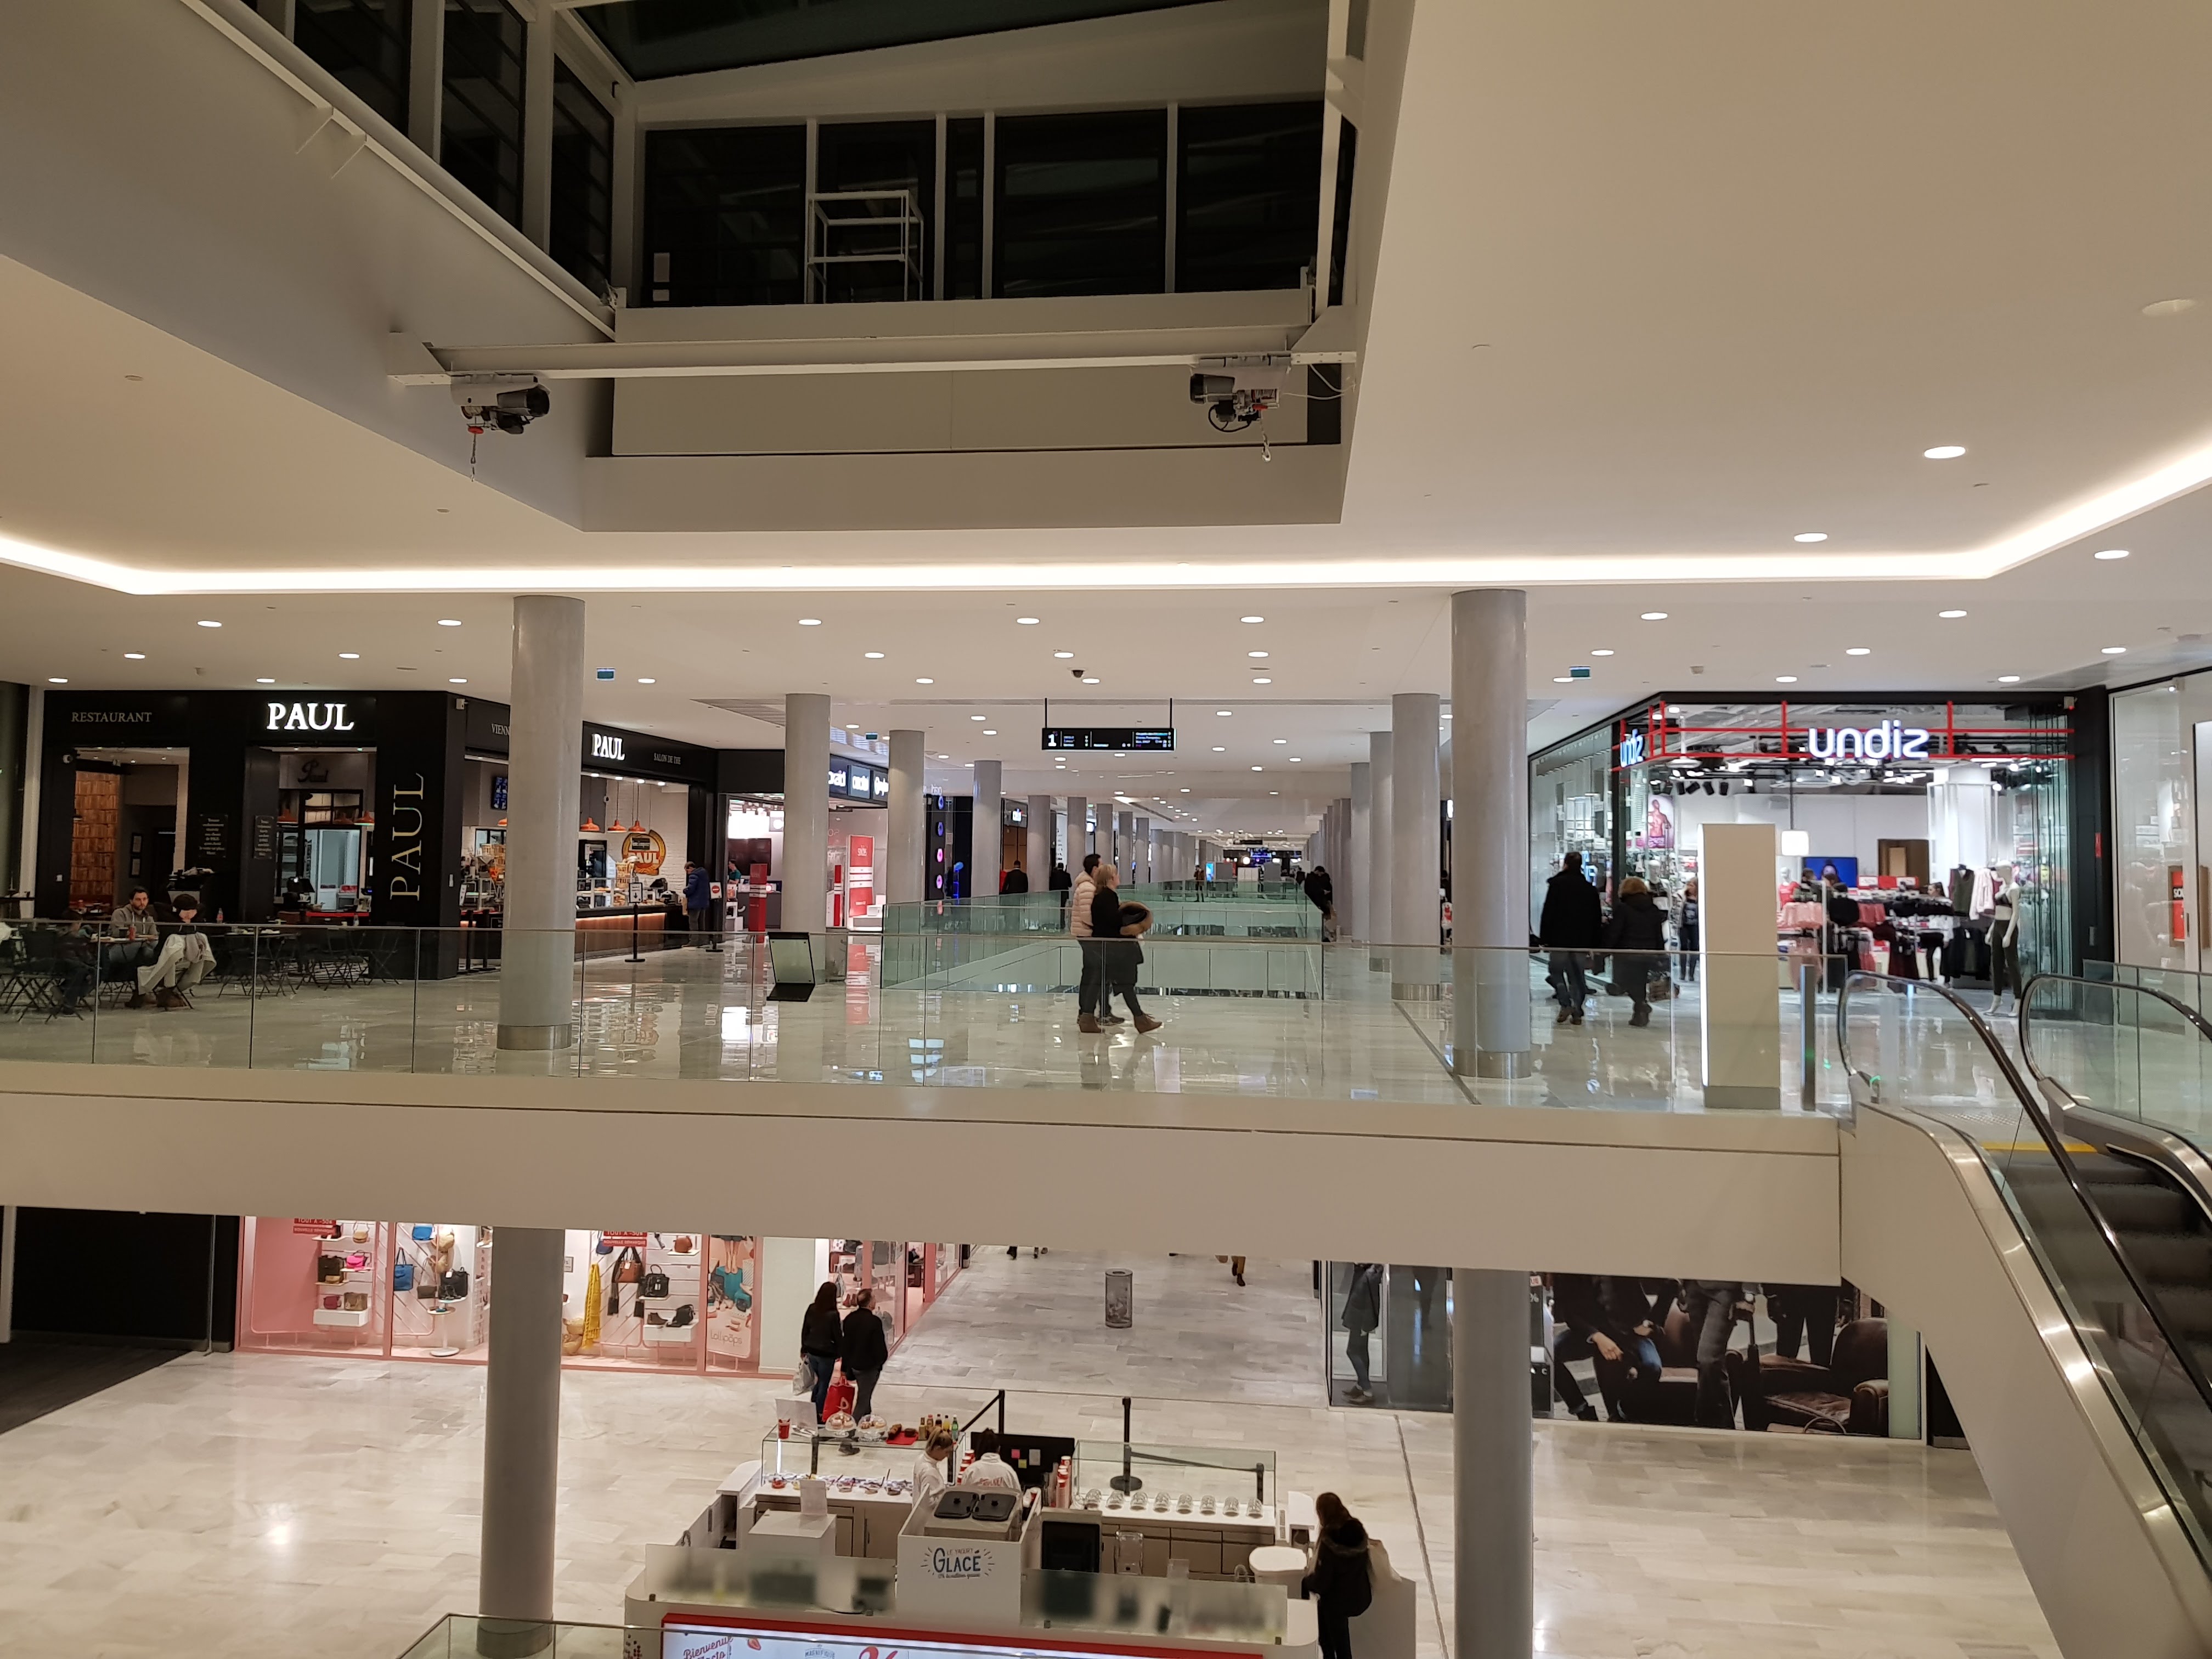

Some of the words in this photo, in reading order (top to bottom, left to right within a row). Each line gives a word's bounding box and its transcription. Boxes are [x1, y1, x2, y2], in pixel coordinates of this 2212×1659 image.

[71, 712, 152, 722] RESTAURANT
[267, 703, 354, 730] PAUL
[592, 733, 625, 760] PAUL
[1048, 734, 1057, 747] 1
[1809, 719, 1929, 759] undiz
[653, 752, 667, 762] SALON
[667, 755, 673, 763] DE
[390, 772, 424, 901] PAUL
[933, 1548, 981, 1573] GLACÉ
